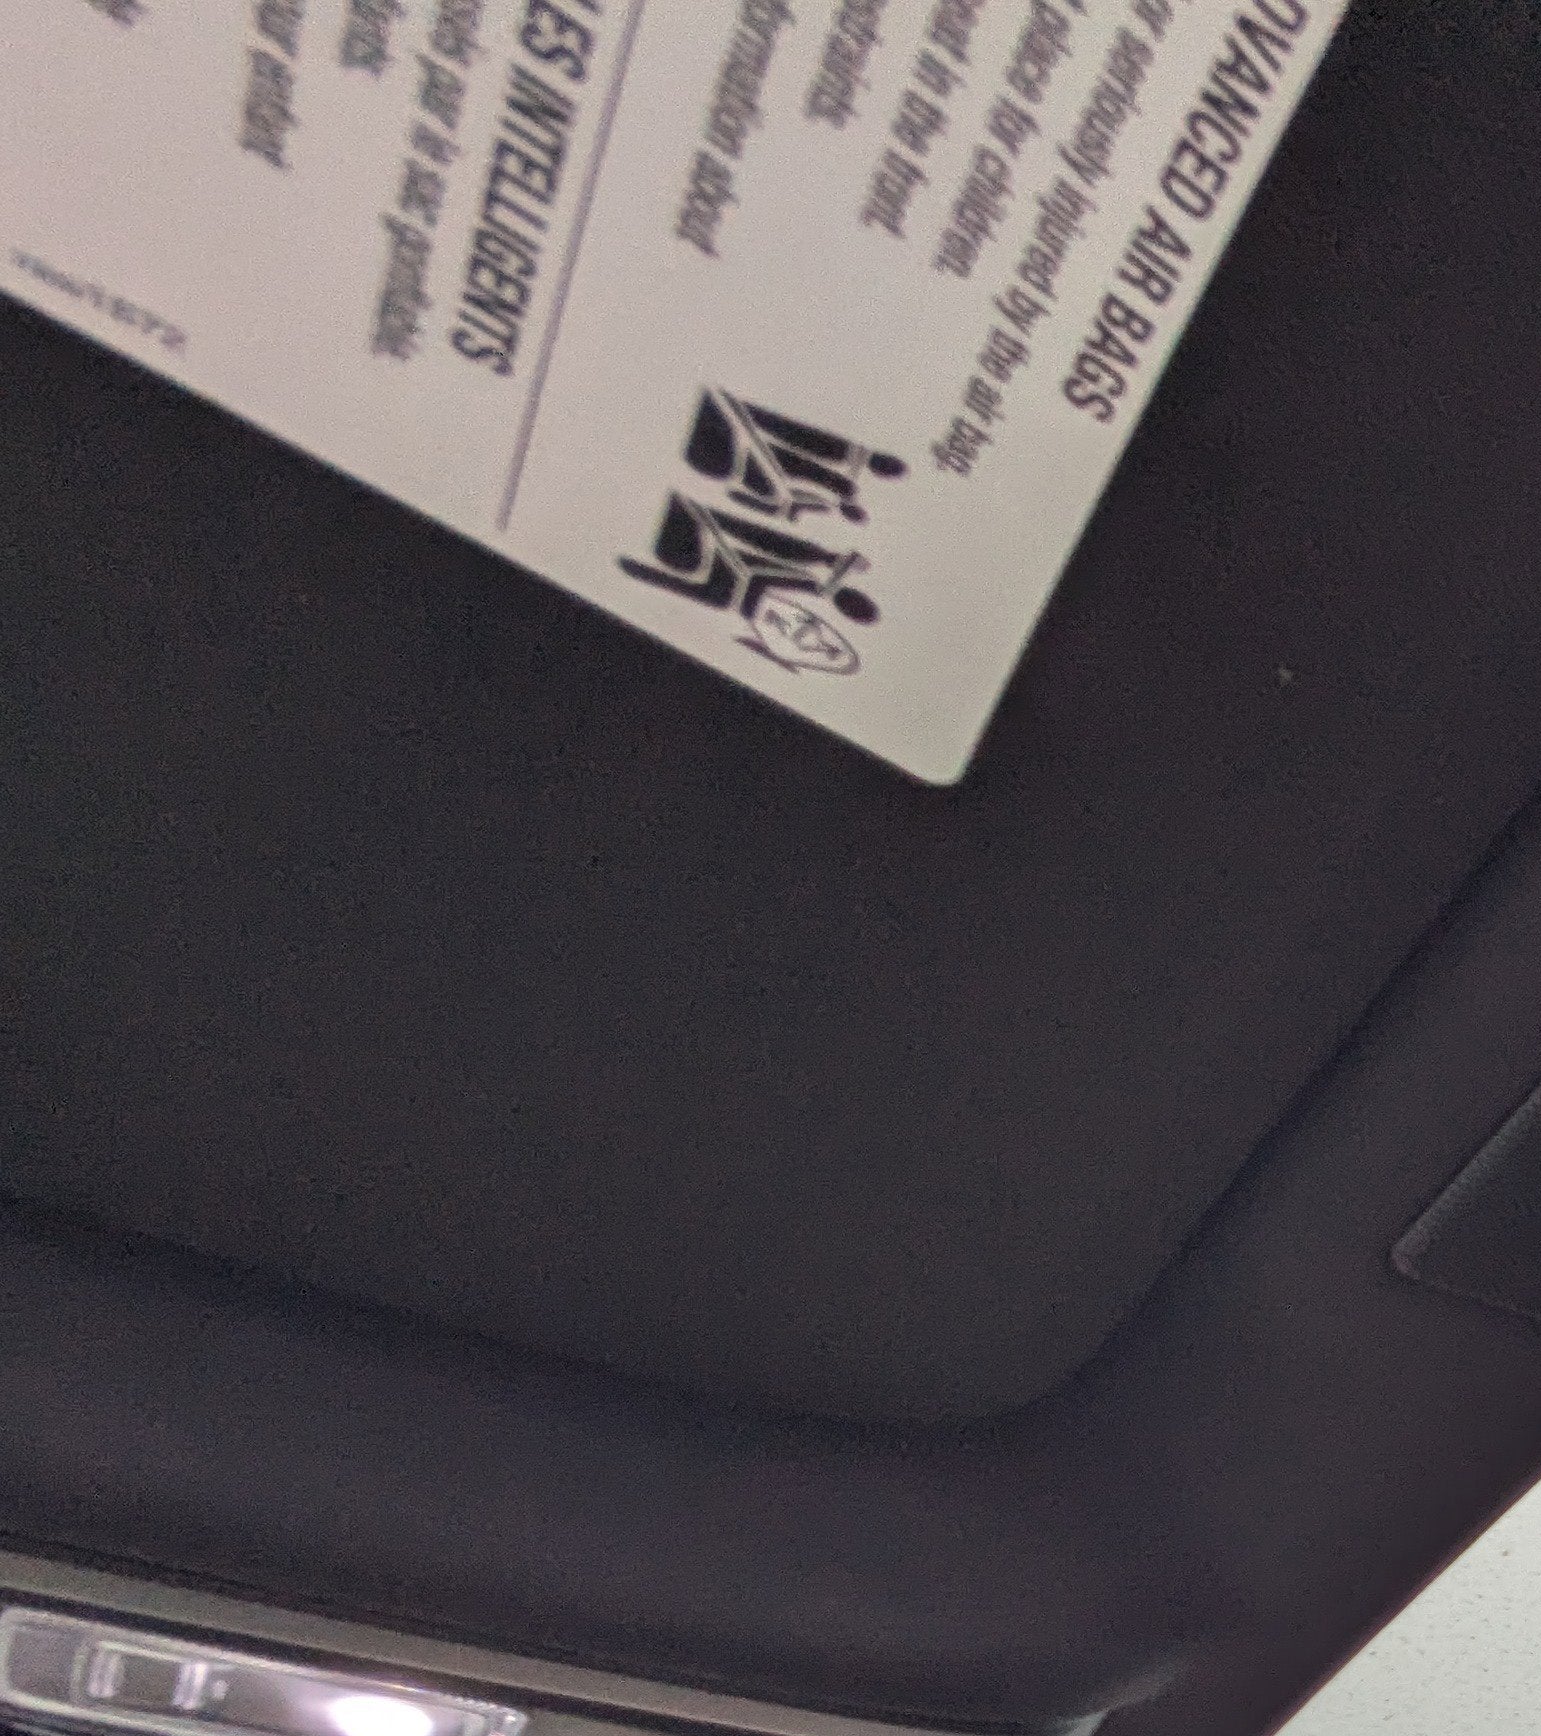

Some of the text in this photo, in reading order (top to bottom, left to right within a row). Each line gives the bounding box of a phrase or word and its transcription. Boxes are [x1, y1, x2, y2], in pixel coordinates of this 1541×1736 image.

[913, 49, 963, 99] in
[1056, 26, 1154, 188] seriously
[890, 89, 949, 156] the
[986, 96, 1040, 158] for
[448, 62, 577, 378] INTELLIGENTS
[673, 149, 738, 258] about
[859, 148, 929, 239] front.
[932, 145, 1012, 279] children.
[1015, 177, 1097, 300] injured
[1114, 203, 1193, 307] AIR
[977, 326, 1031, 383] the
[992, 285, 1051, 336] by
[955, 375, 1004, 429] air
[1060, 290, 1156, 423] BAGS
[929, 416, 993, 477] bag.
